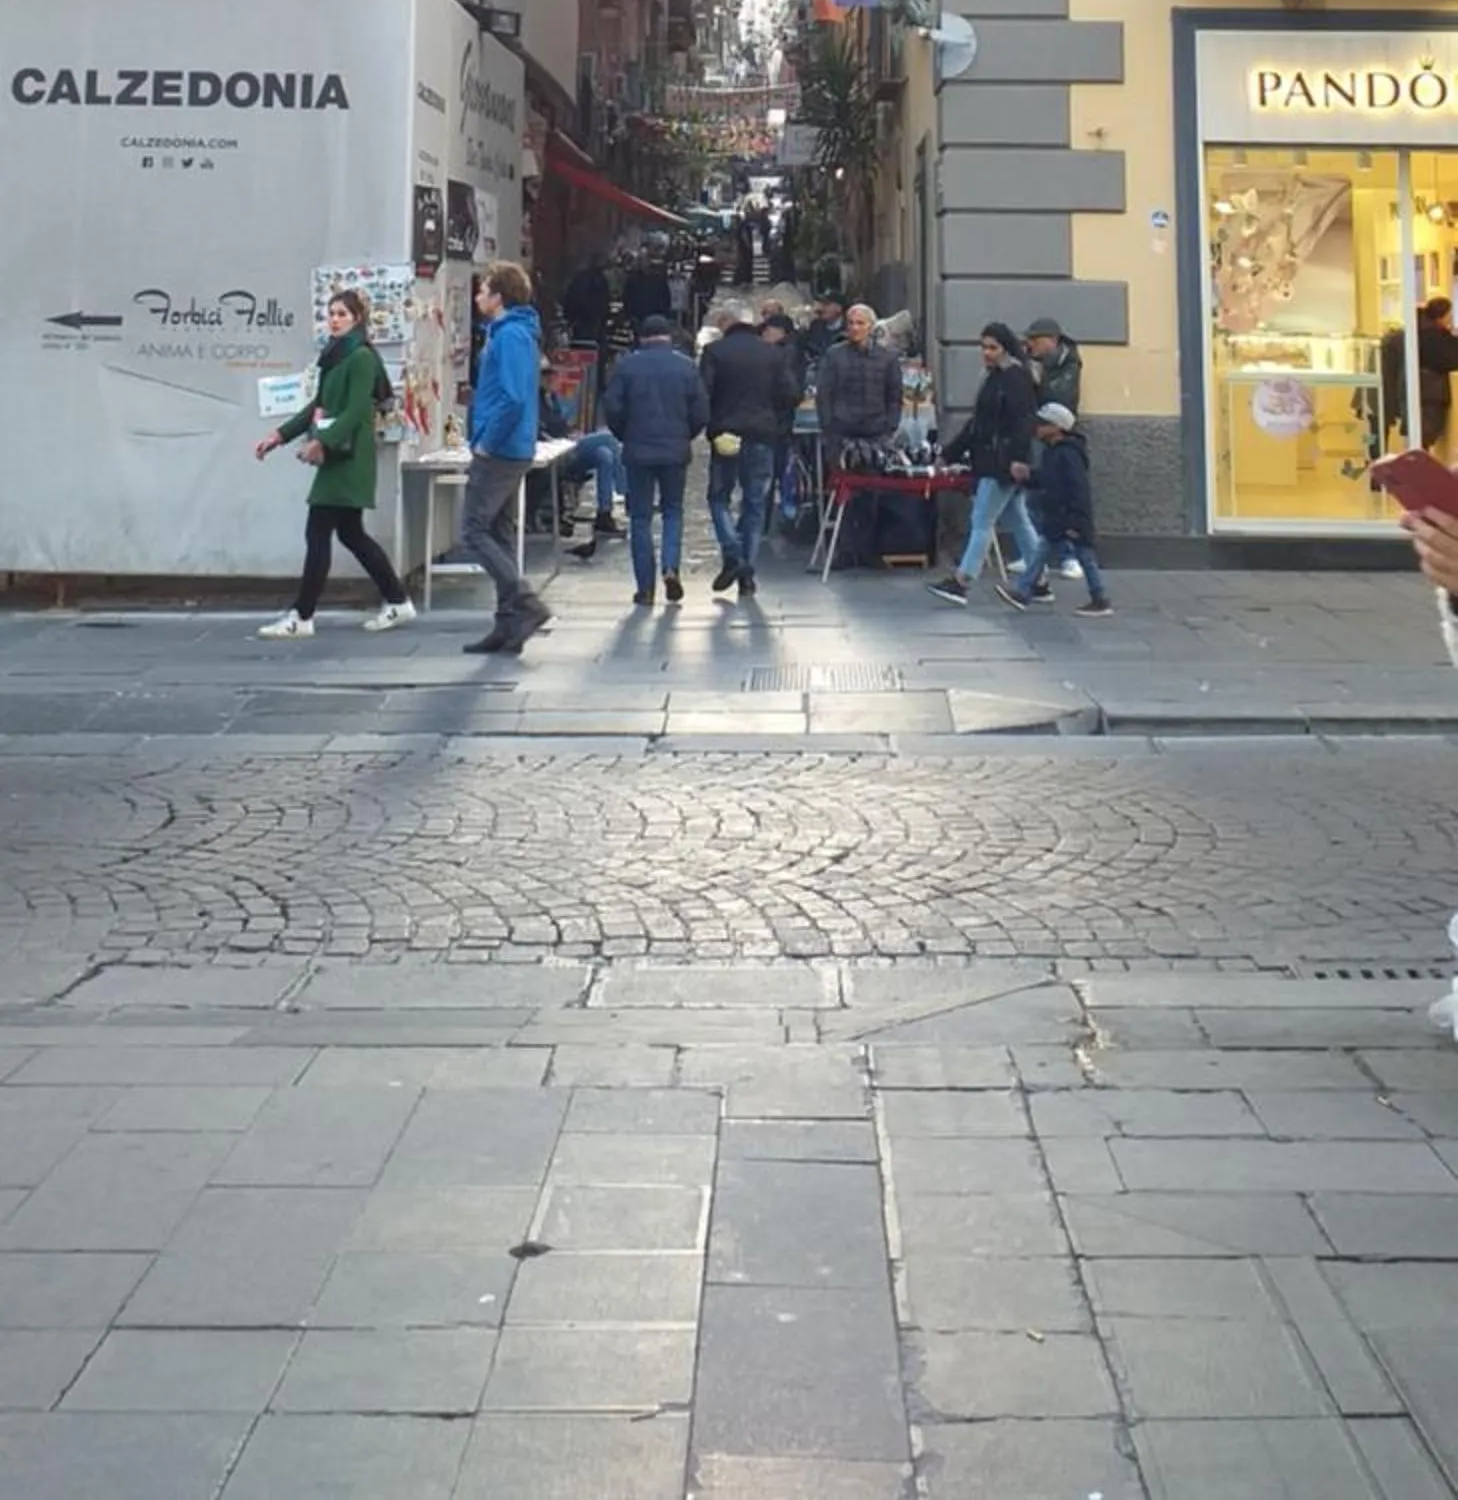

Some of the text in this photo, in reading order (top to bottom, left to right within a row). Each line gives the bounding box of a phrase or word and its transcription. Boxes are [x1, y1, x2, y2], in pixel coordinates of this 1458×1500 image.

[11, 68, 350, 109] CALZEDONIA
[1258, 70, 1448, 109] PANDO
[218, 289, 295, 328] Follie
